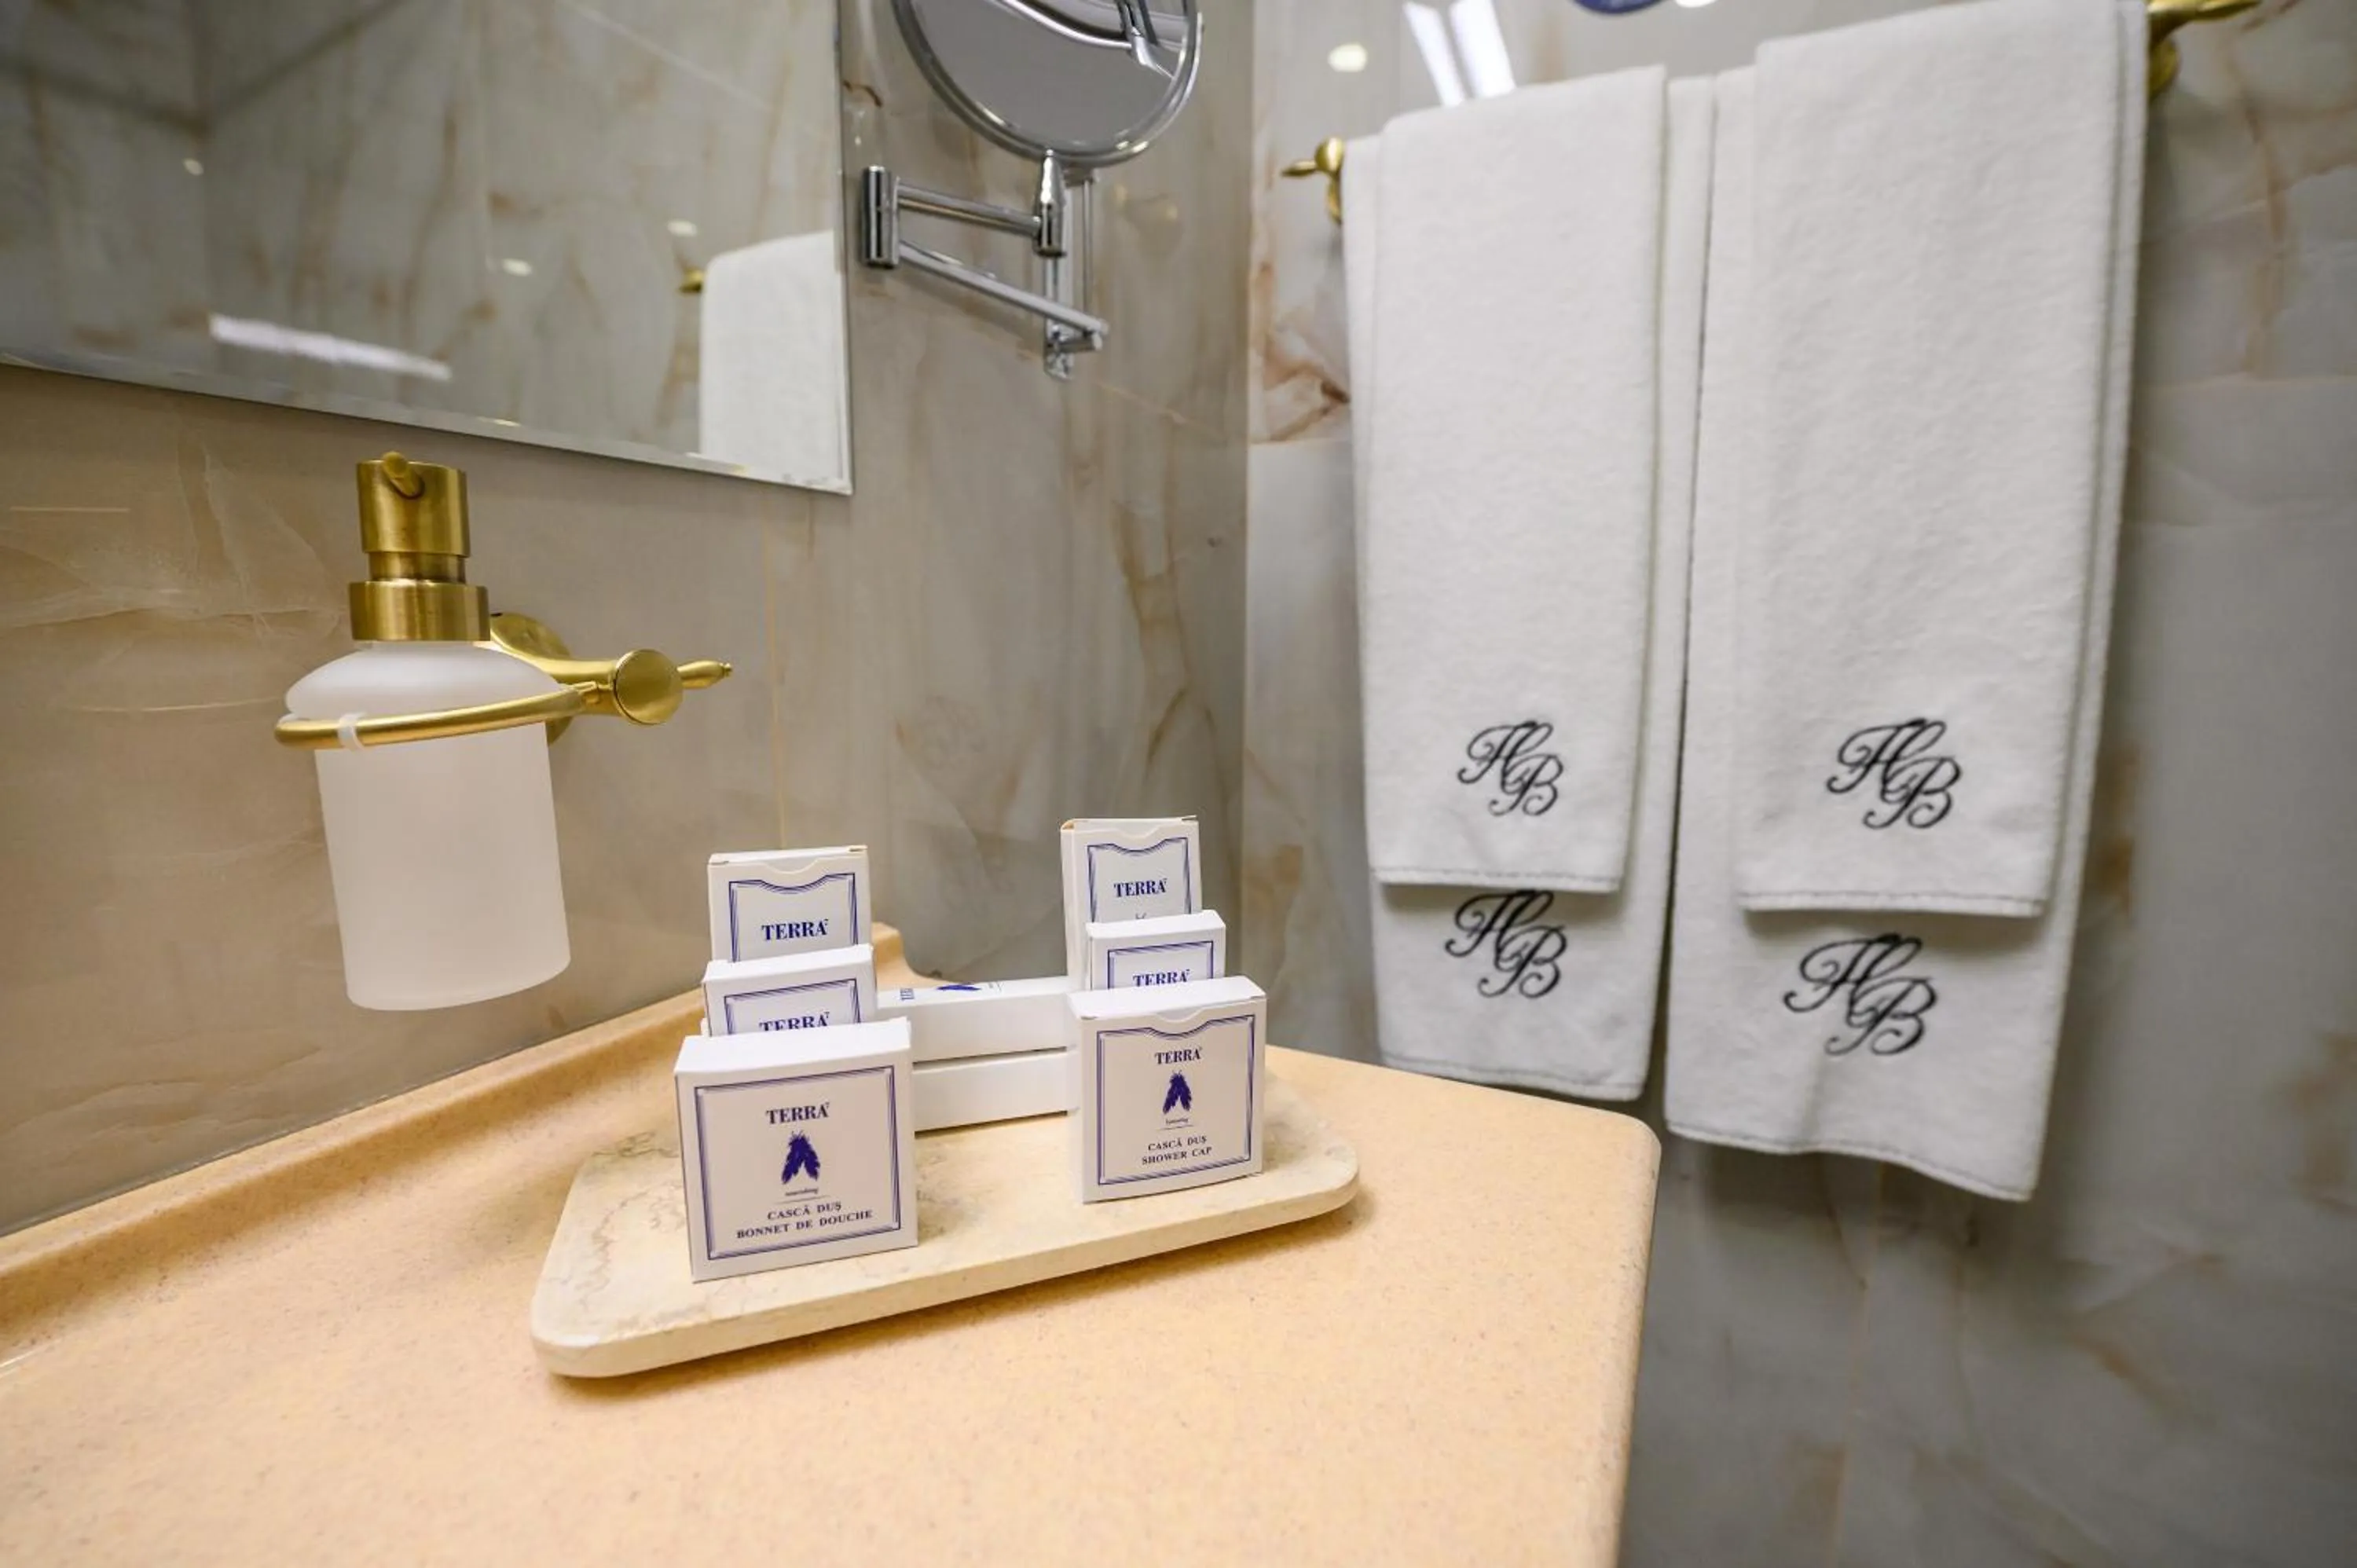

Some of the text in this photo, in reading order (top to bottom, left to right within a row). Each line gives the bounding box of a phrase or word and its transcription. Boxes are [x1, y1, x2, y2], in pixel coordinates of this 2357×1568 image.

[1113, 877, 1168, 898] TERRA
[761, 918, 829, 940] TERRA
[1155, 1046, 1202, 1064] TERRA
[766, 1101, 830, 1124] TERRA
[1142, 1146, 1212, 1165] SHOWER CAP
[736, 1209, 874, 1239] BONNET DE DOUCHE
